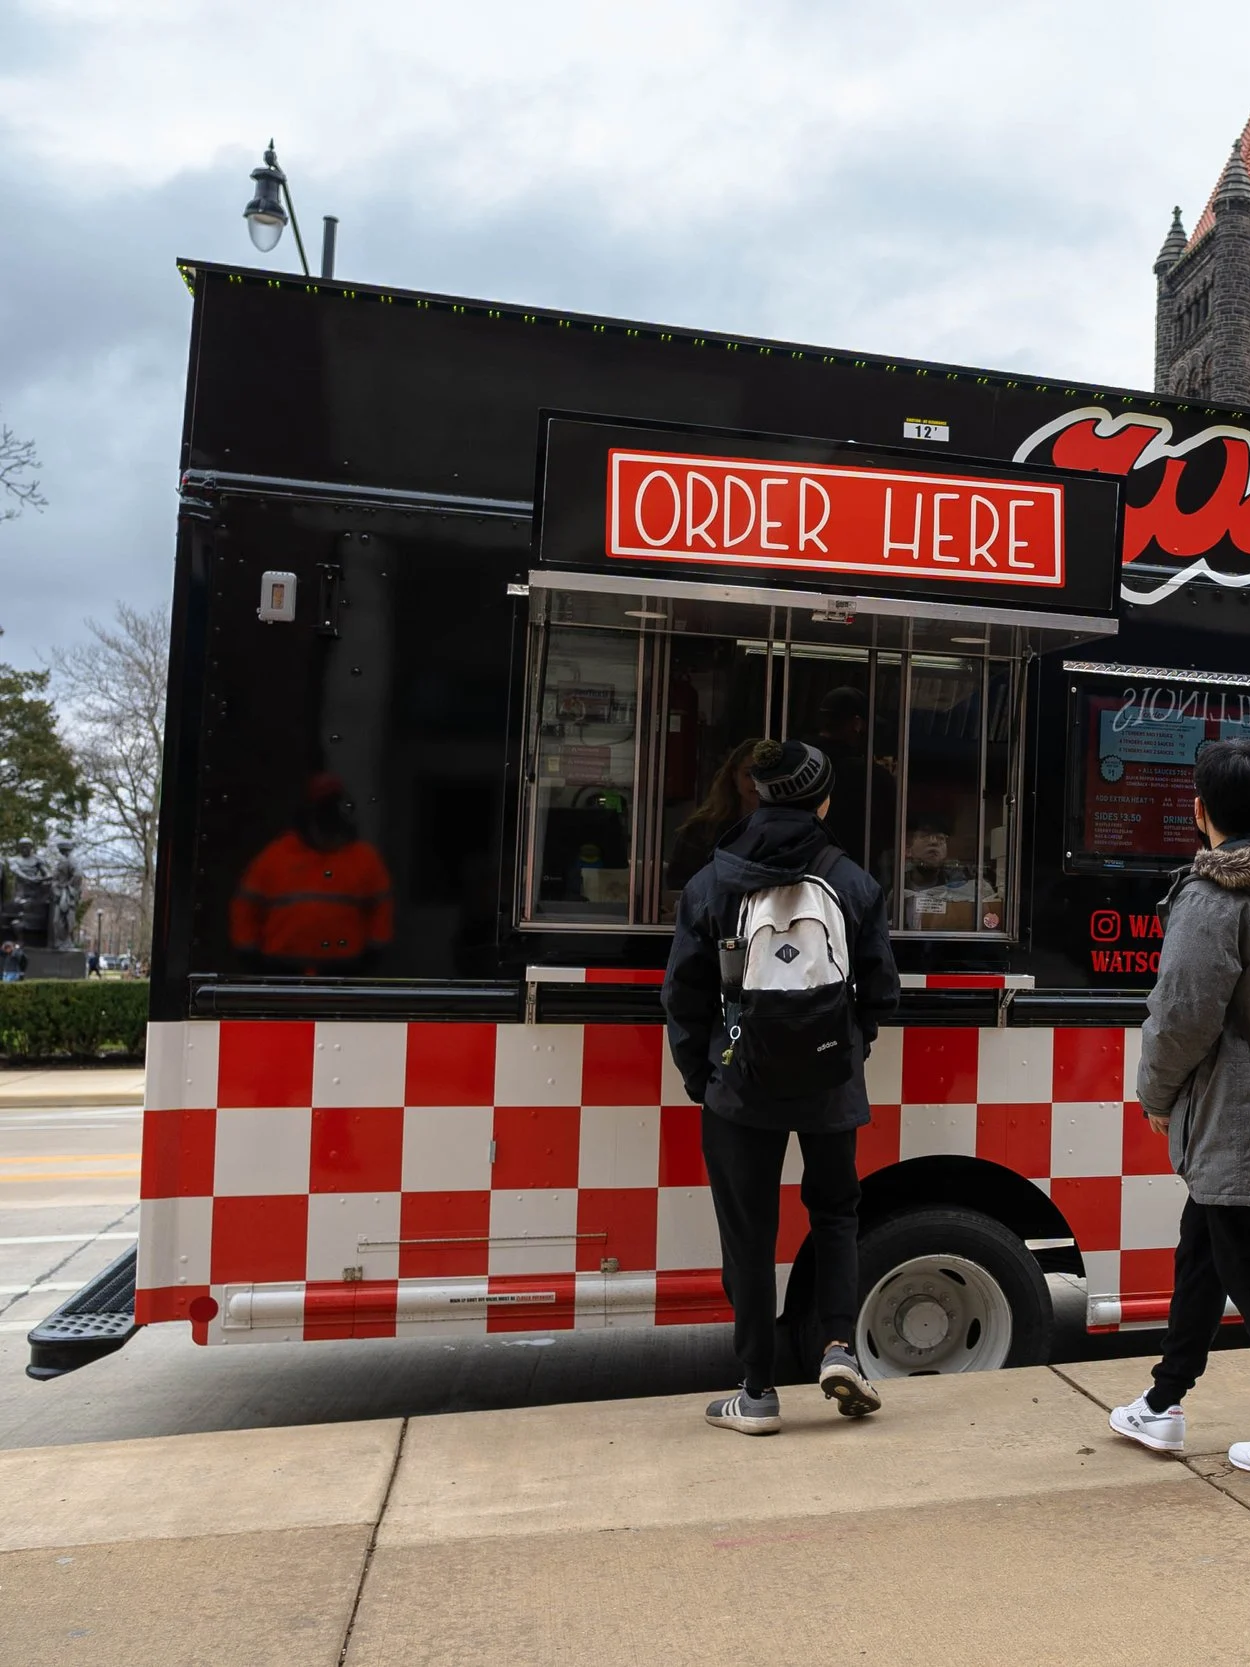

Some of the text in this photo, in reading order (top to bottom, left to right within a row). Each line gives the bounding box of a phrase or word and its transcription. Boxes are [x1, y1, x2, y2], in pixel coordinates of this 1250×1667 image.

[634, 469, 1036, 569] ORDER HERE
[768, 758, 821, 801] PUMA
[1094, 812, 1118, 821] SIDES
[1163, 816, 1193, 825] DRINKS
[1090, 950, 1161, 973] WATSO
[817, 1040, 838, 1052] adidas
